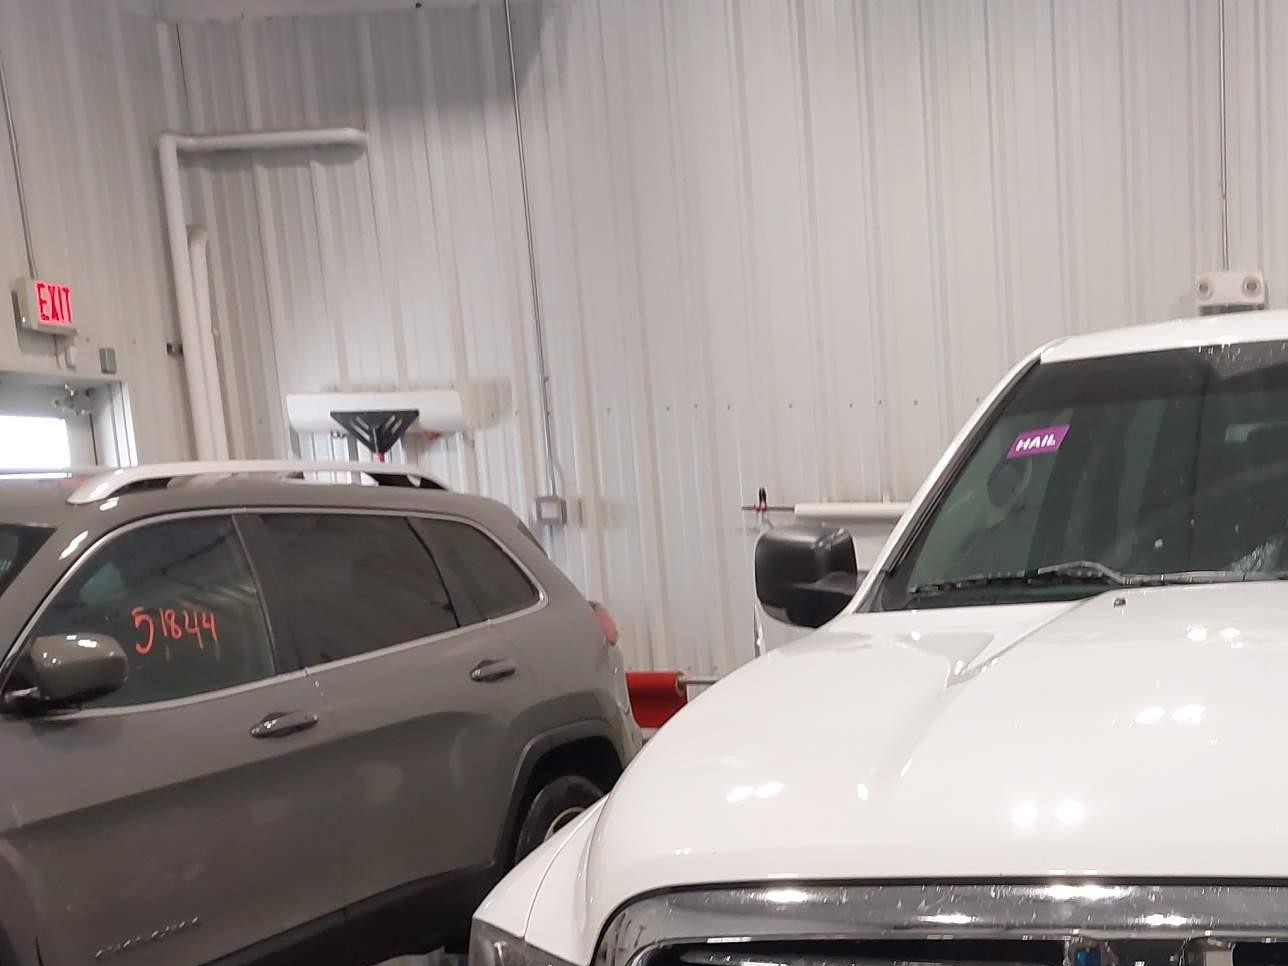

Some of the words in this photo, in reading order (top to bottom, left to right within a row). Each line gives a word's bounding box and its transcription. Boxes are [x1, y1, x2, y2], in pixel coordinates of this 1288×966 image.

[36, 282, 72, 323] EXIT
[1016, 433, 1056, 452] HAIL
[131, 606, 219, 655] 51844
